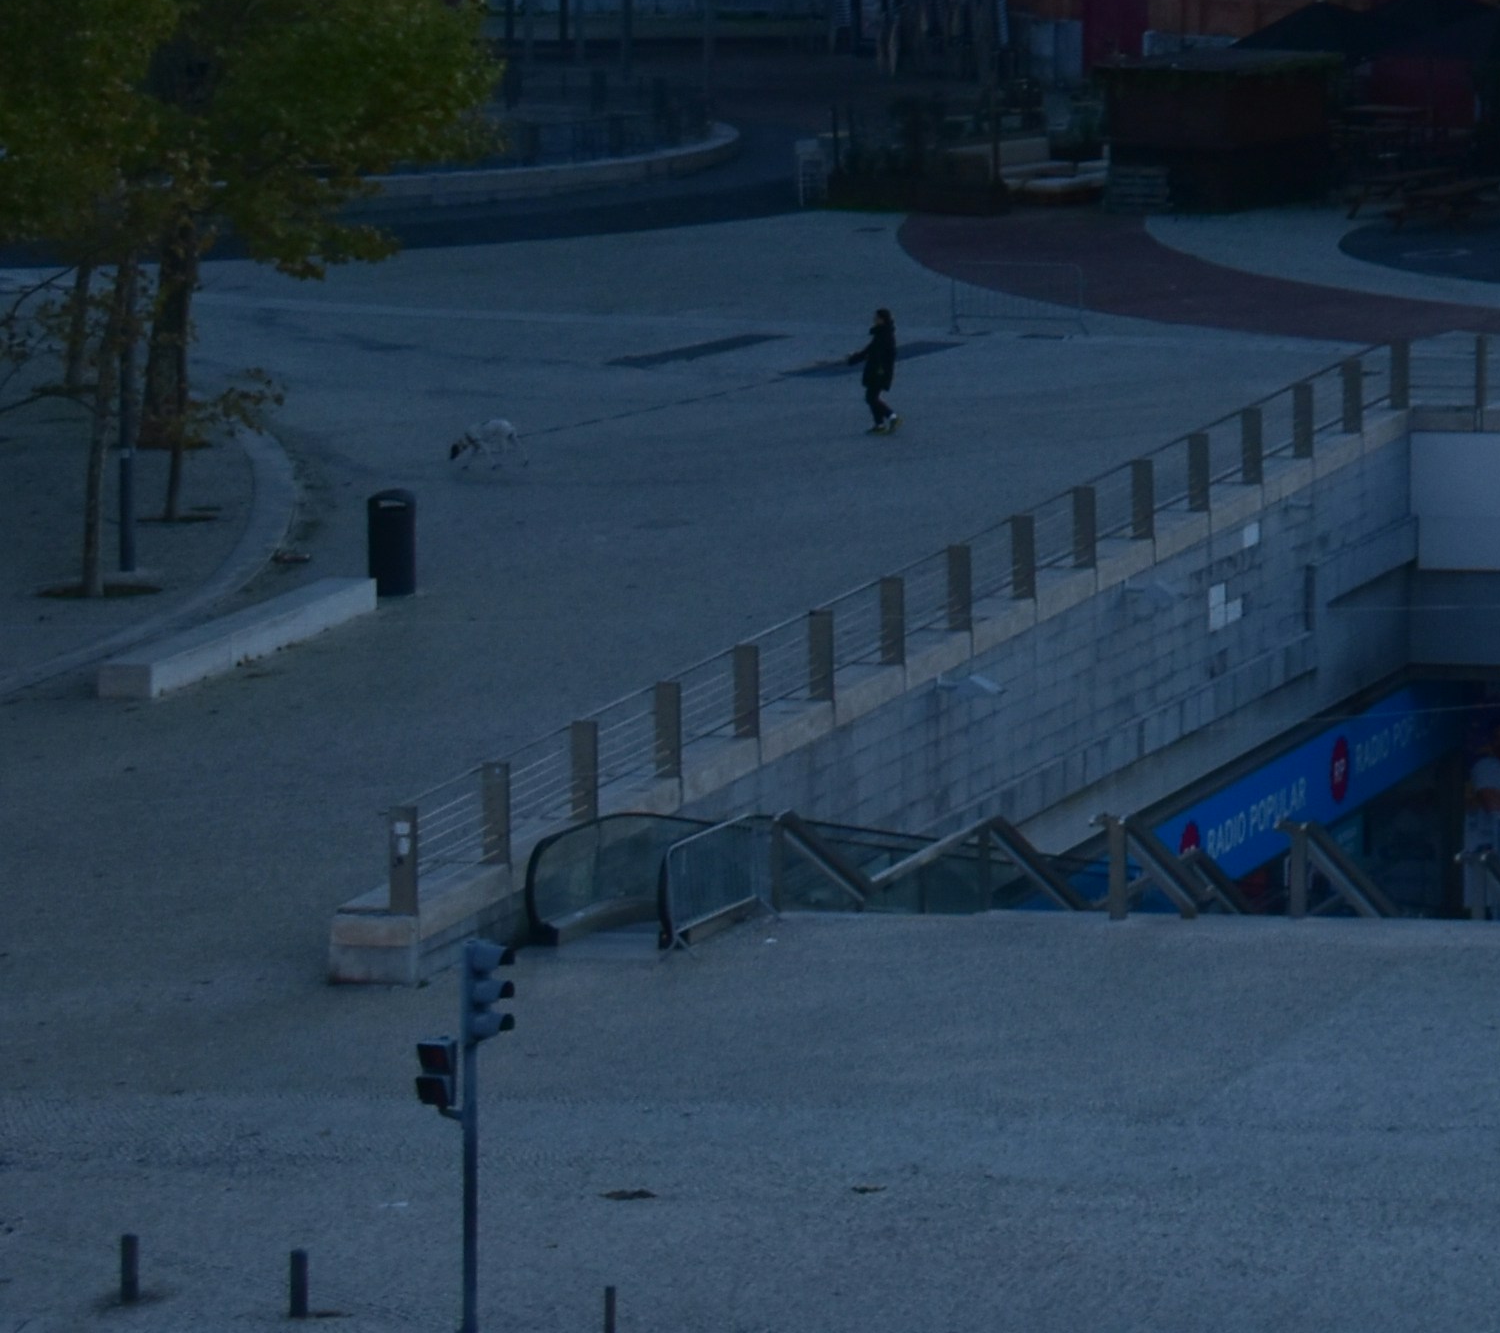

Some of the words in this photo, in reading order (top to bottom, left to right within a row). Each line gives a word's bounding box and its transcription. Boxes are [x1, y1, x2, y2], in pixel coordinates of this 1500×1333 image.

[1355, 727, 1389, 774] RADIO
[1207, 810, 1246, 861] RADIO
[1249, 776, 1307, 838] POPULAR
